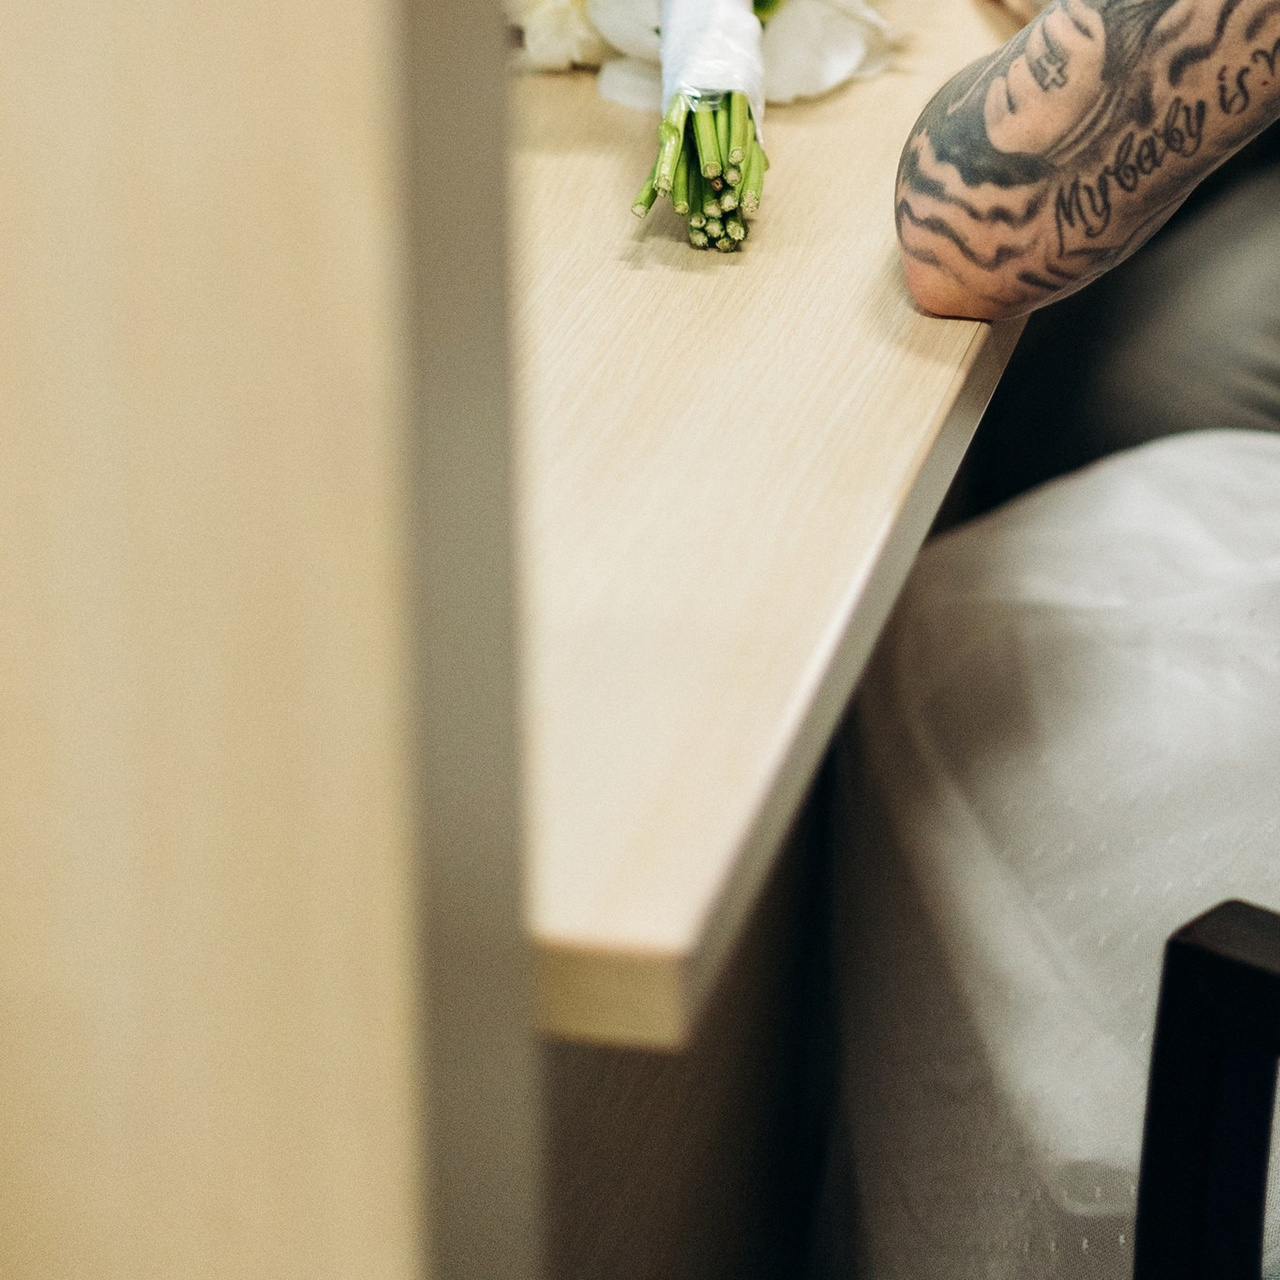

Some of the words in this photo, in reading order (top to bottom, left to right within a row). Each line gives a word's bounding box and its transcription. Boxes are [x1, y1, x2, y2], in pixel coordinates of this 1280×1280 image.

[1055, 172, 1111, 258] My
[1104, 96, 1207, 193] baby
[1217, 64, 1250, 116] is
